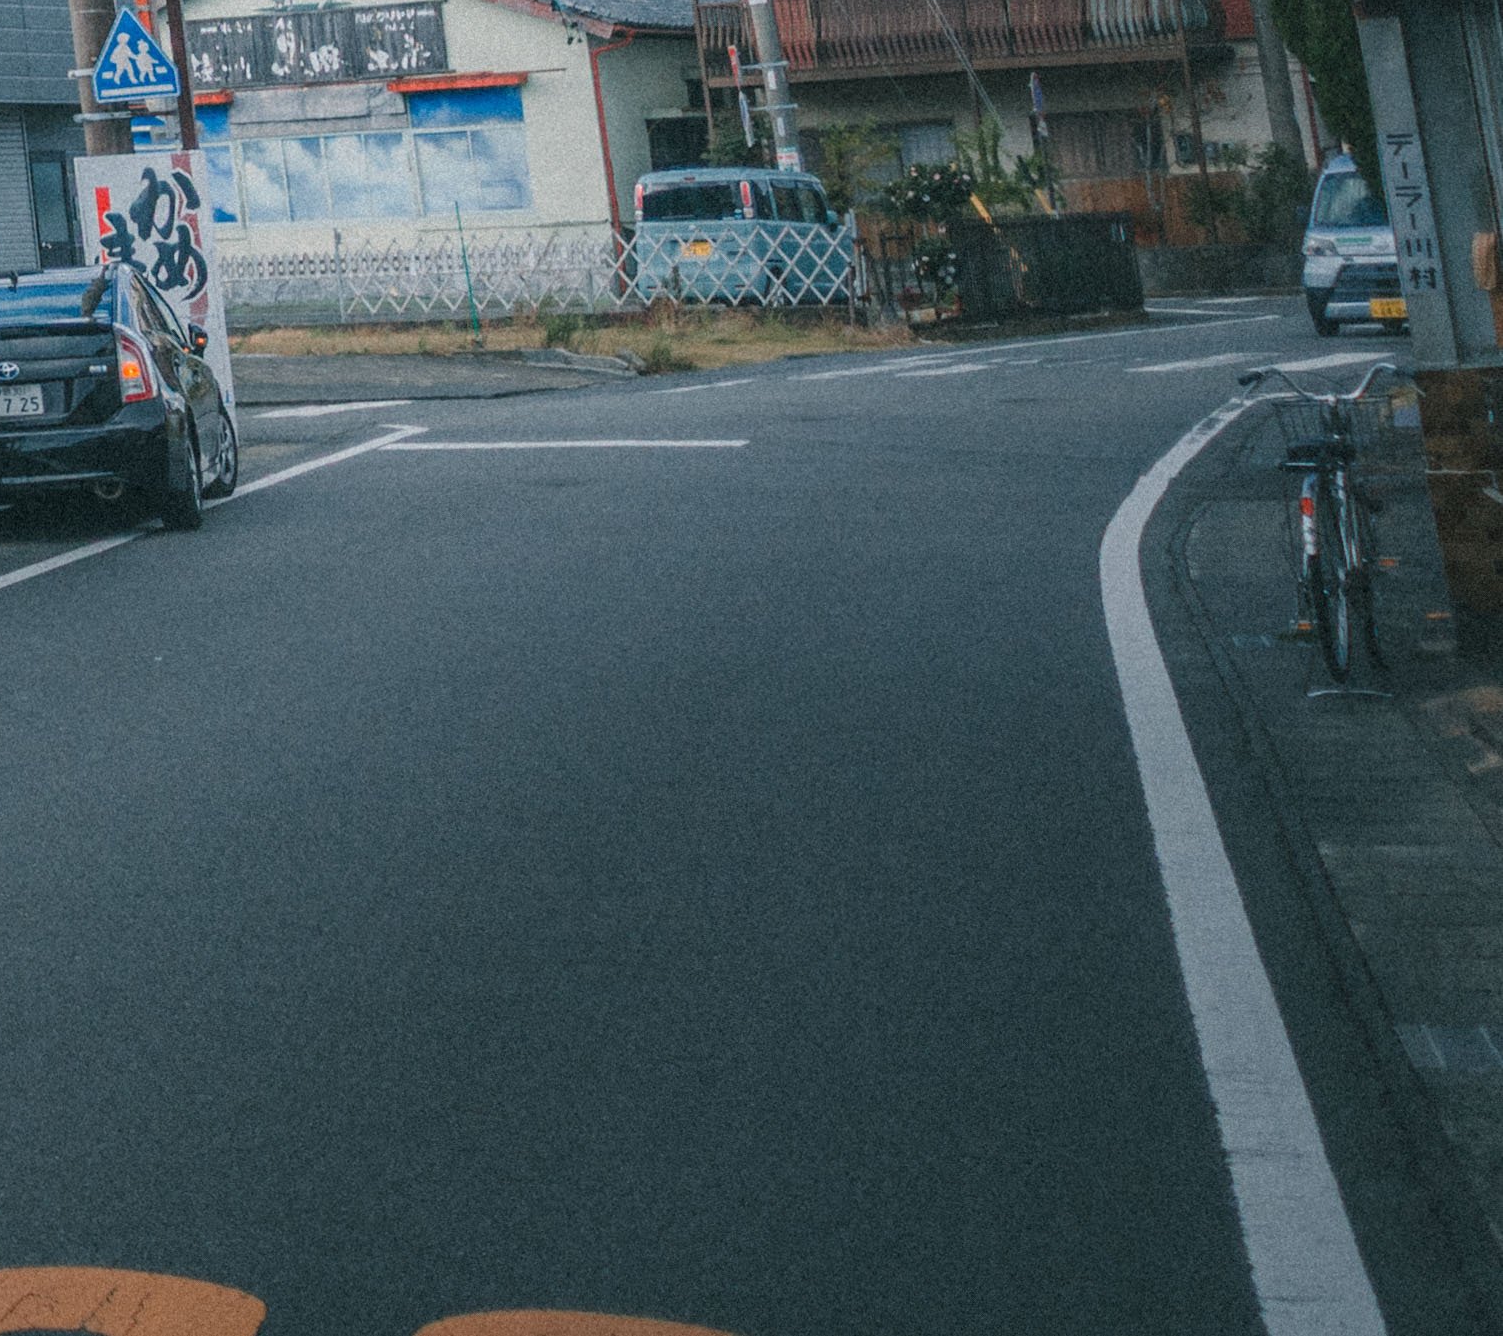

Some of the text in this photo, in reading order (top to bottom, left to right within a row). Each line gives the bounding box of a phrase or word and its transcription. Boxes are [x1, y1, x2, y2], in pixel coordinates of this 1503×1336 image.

[1386, 134, 1436, 289] テーラー川村
